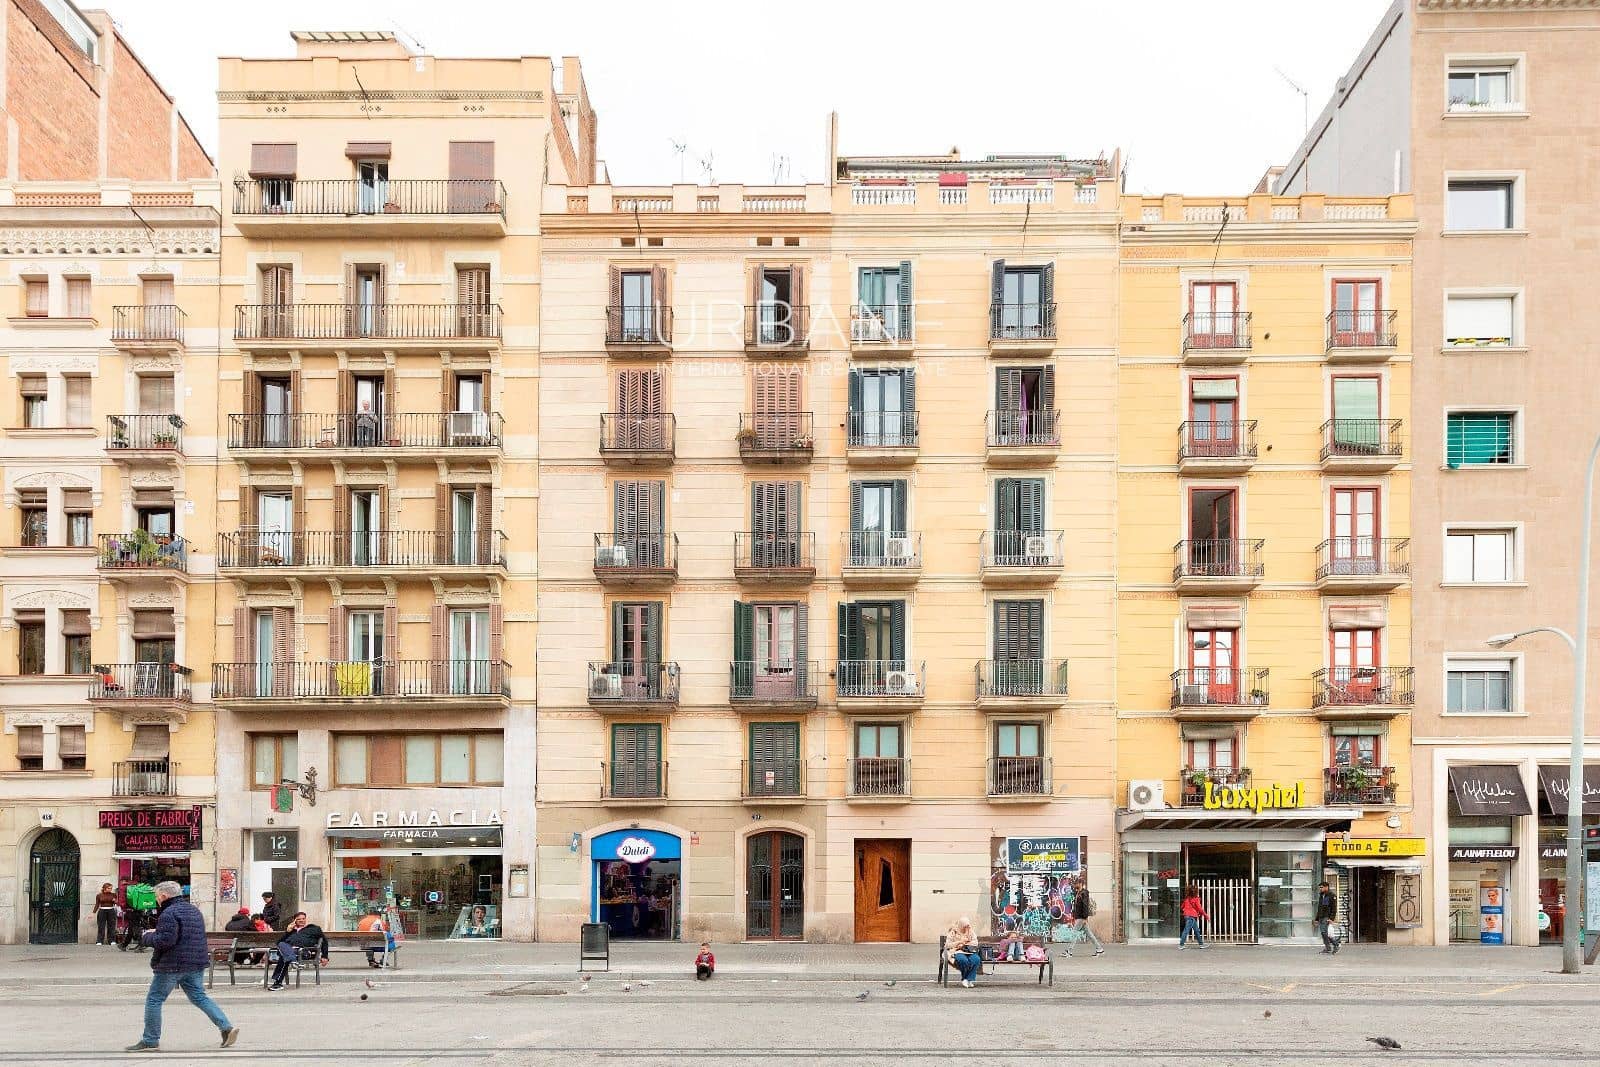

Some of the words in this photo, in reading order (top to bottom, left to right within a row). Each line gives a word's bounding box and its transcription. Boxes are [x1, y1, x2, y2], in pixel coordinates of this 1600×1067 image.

[1204, 780, 1305, 814] Luxpiel
[100, 812, 133, 827] PREUS
[137, 812, 150, 827] DE
[191, 805, 200, 841] OUTLET
[267, 817, 274, 825] 12
[326, 808, 503, 827] FARMÀCIA
[124, 835, 158, 846] CALÇATS
[161, 834, 186, 845] ROUSE
[383, 830, 439, 838] FARMACIA
[270, 835, 287, 850] 12
[1034, 842, 1068, 850] ARETAIL
[1333, 843, 1361, 851] TODO
[622, 845, 649, 856] Duldi
